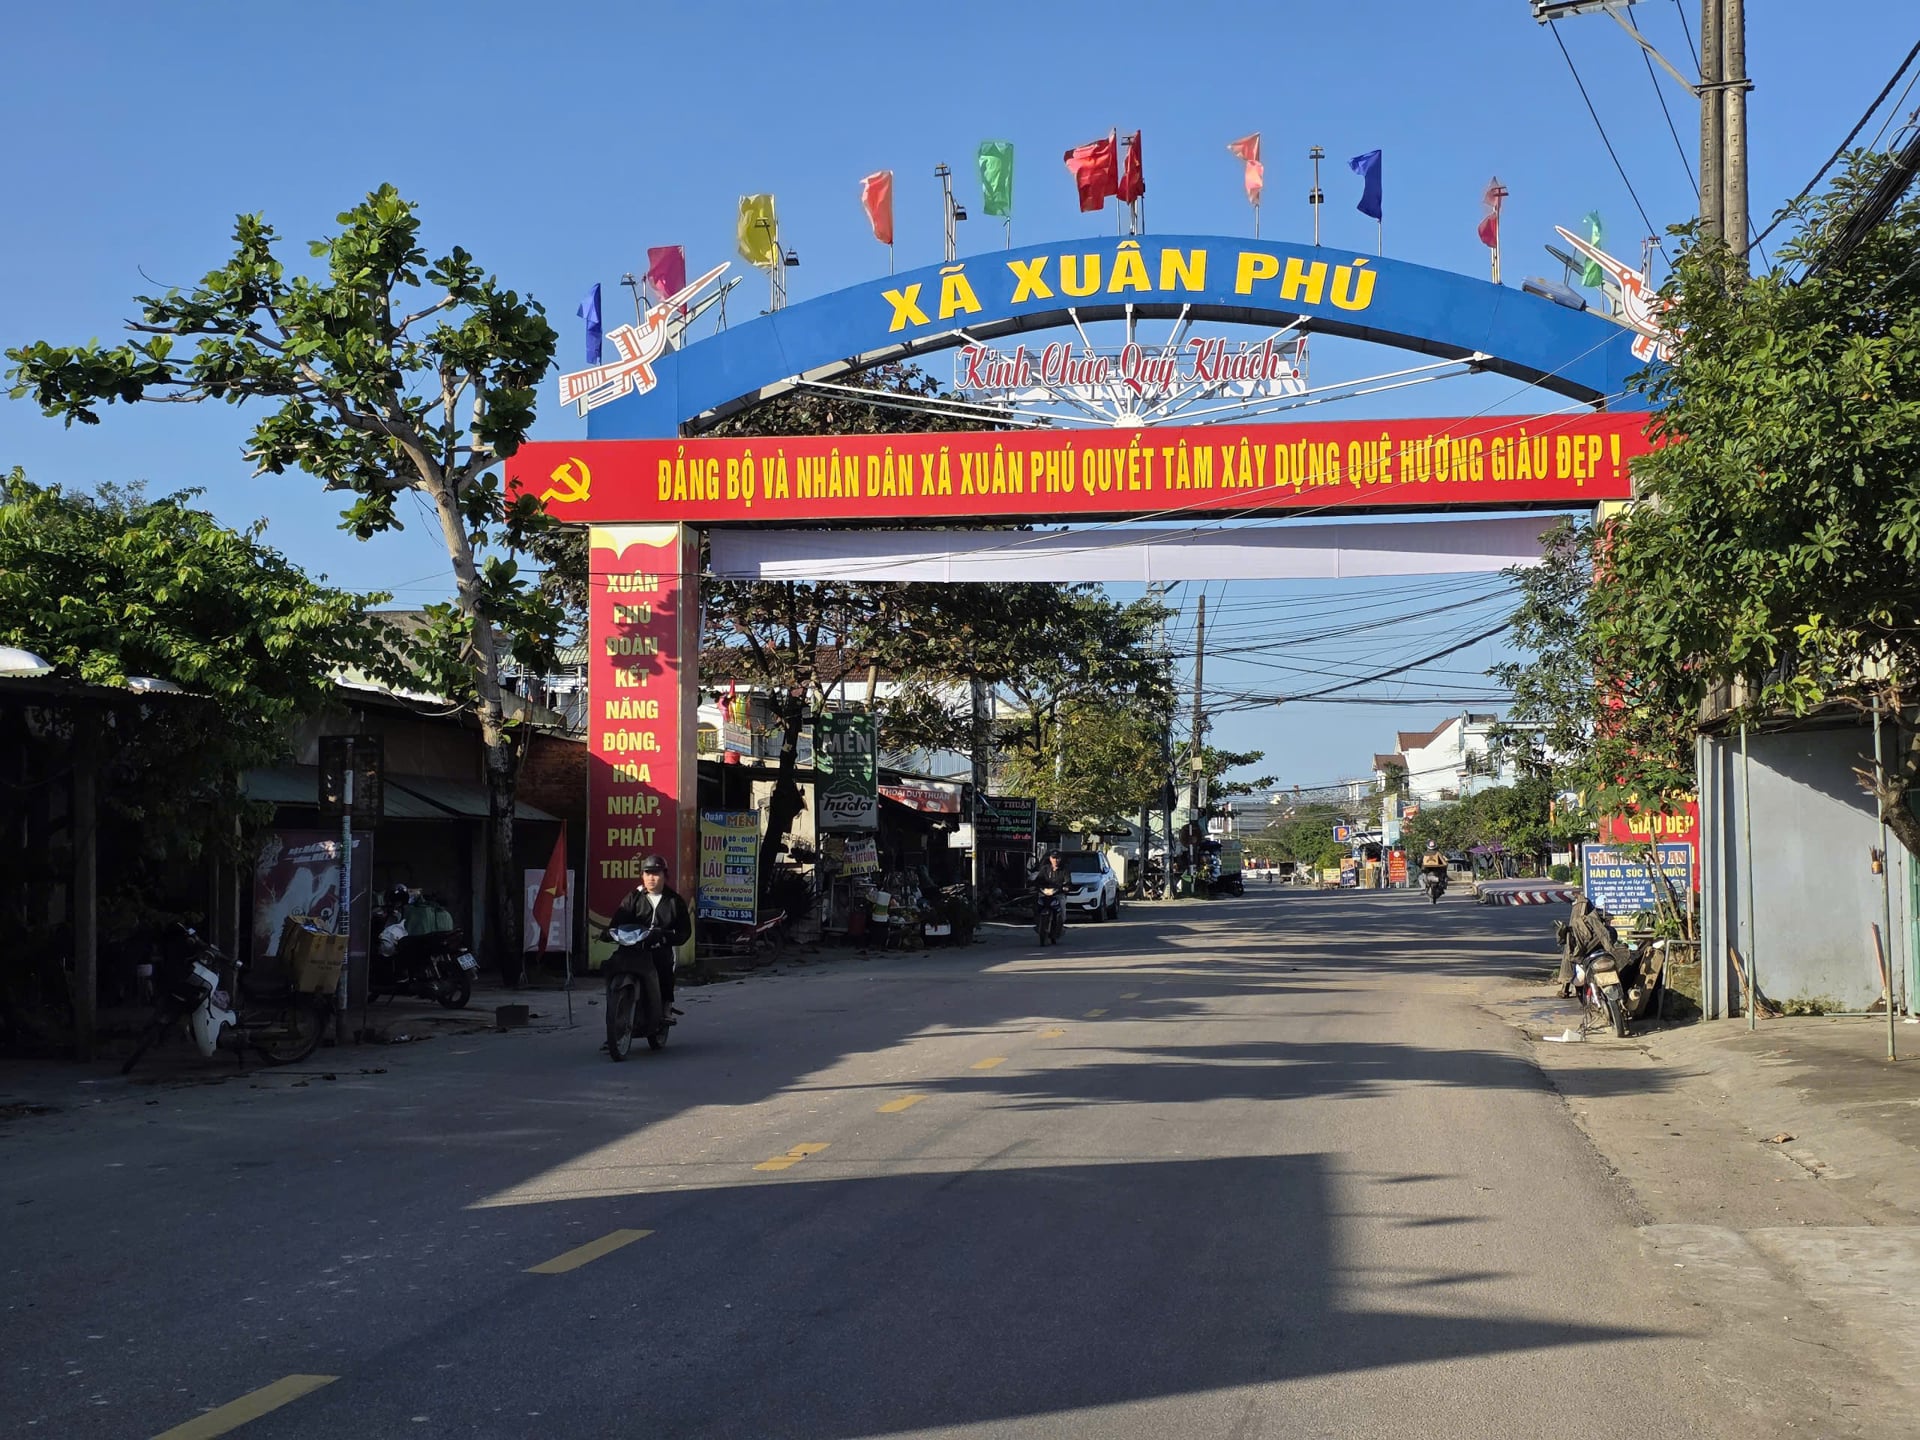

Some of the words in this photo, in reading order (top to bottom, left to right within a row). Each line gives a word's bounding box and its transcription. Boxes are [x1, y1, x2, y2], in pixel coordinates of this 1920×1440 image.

[881, 264, 982, 332] XÃ
[1006, 240, 1207, 303] XUÂN
[1234, 251, 1377, 311] PHÚ
[956, 347, 1032, 389] Kính
[1041, 342, 1111, 388] Chào
[1118, 342, 1177, 395] Quý
[1181, 338, 1281, 386] Khách
[657, 447, 719, 501] ĐẢNG
[726, 450, 755, 508] BỘ
[761, 449, 789, 499] VÀ
[796, 448, 860, 499] NHÂN
[867, 447, 914, 497] DÂN
[921, 446, 953, 496] XÃ
[960, 443, 1024, 495] XUÂN
[1030, 441, 1075, 494] PHÚ
[1082, 432, 1155, 494] QUYẾT
[1162, 439, 1214, 489] TÂM
[1221, 437, 1267, 488] XÂY
[1274, 438, 1340, 495] DỰNG
[1348, 434, 1393, 488] QUÊ
[1399, 433, 1483, 484] HƯƠNG
[1491, 427, 1549, 481] GIÀU
[1556, 433, 1603, 487] ĐẸP
[606, 570, 658, 593] XUÂN
[613, 601, 651, 624] PHÚ
[606, 634, 658, 657] ĐOÀN
[615, 664, 649, 688] KẾT
[605, 696, 659, 720] NĂNG
[602, 731, 661, 756] ĐỘNG,
[613, 761, 651, 783] HÒA
[608, 792, 662, 819] NHẬP,
[823, 794, 874, 812] huda
[906, 790, 923, 798] DUY
[607, 821, 655, 846] PHÁT
[1666, 815, 1694, 838] ĐẸP
[704, 836, 723, 851] UM
[703, 856, 722, 878] LẨU
[1668, 851, 1686, 865] AN
[1590, 868, 1607, 878] HÀN
